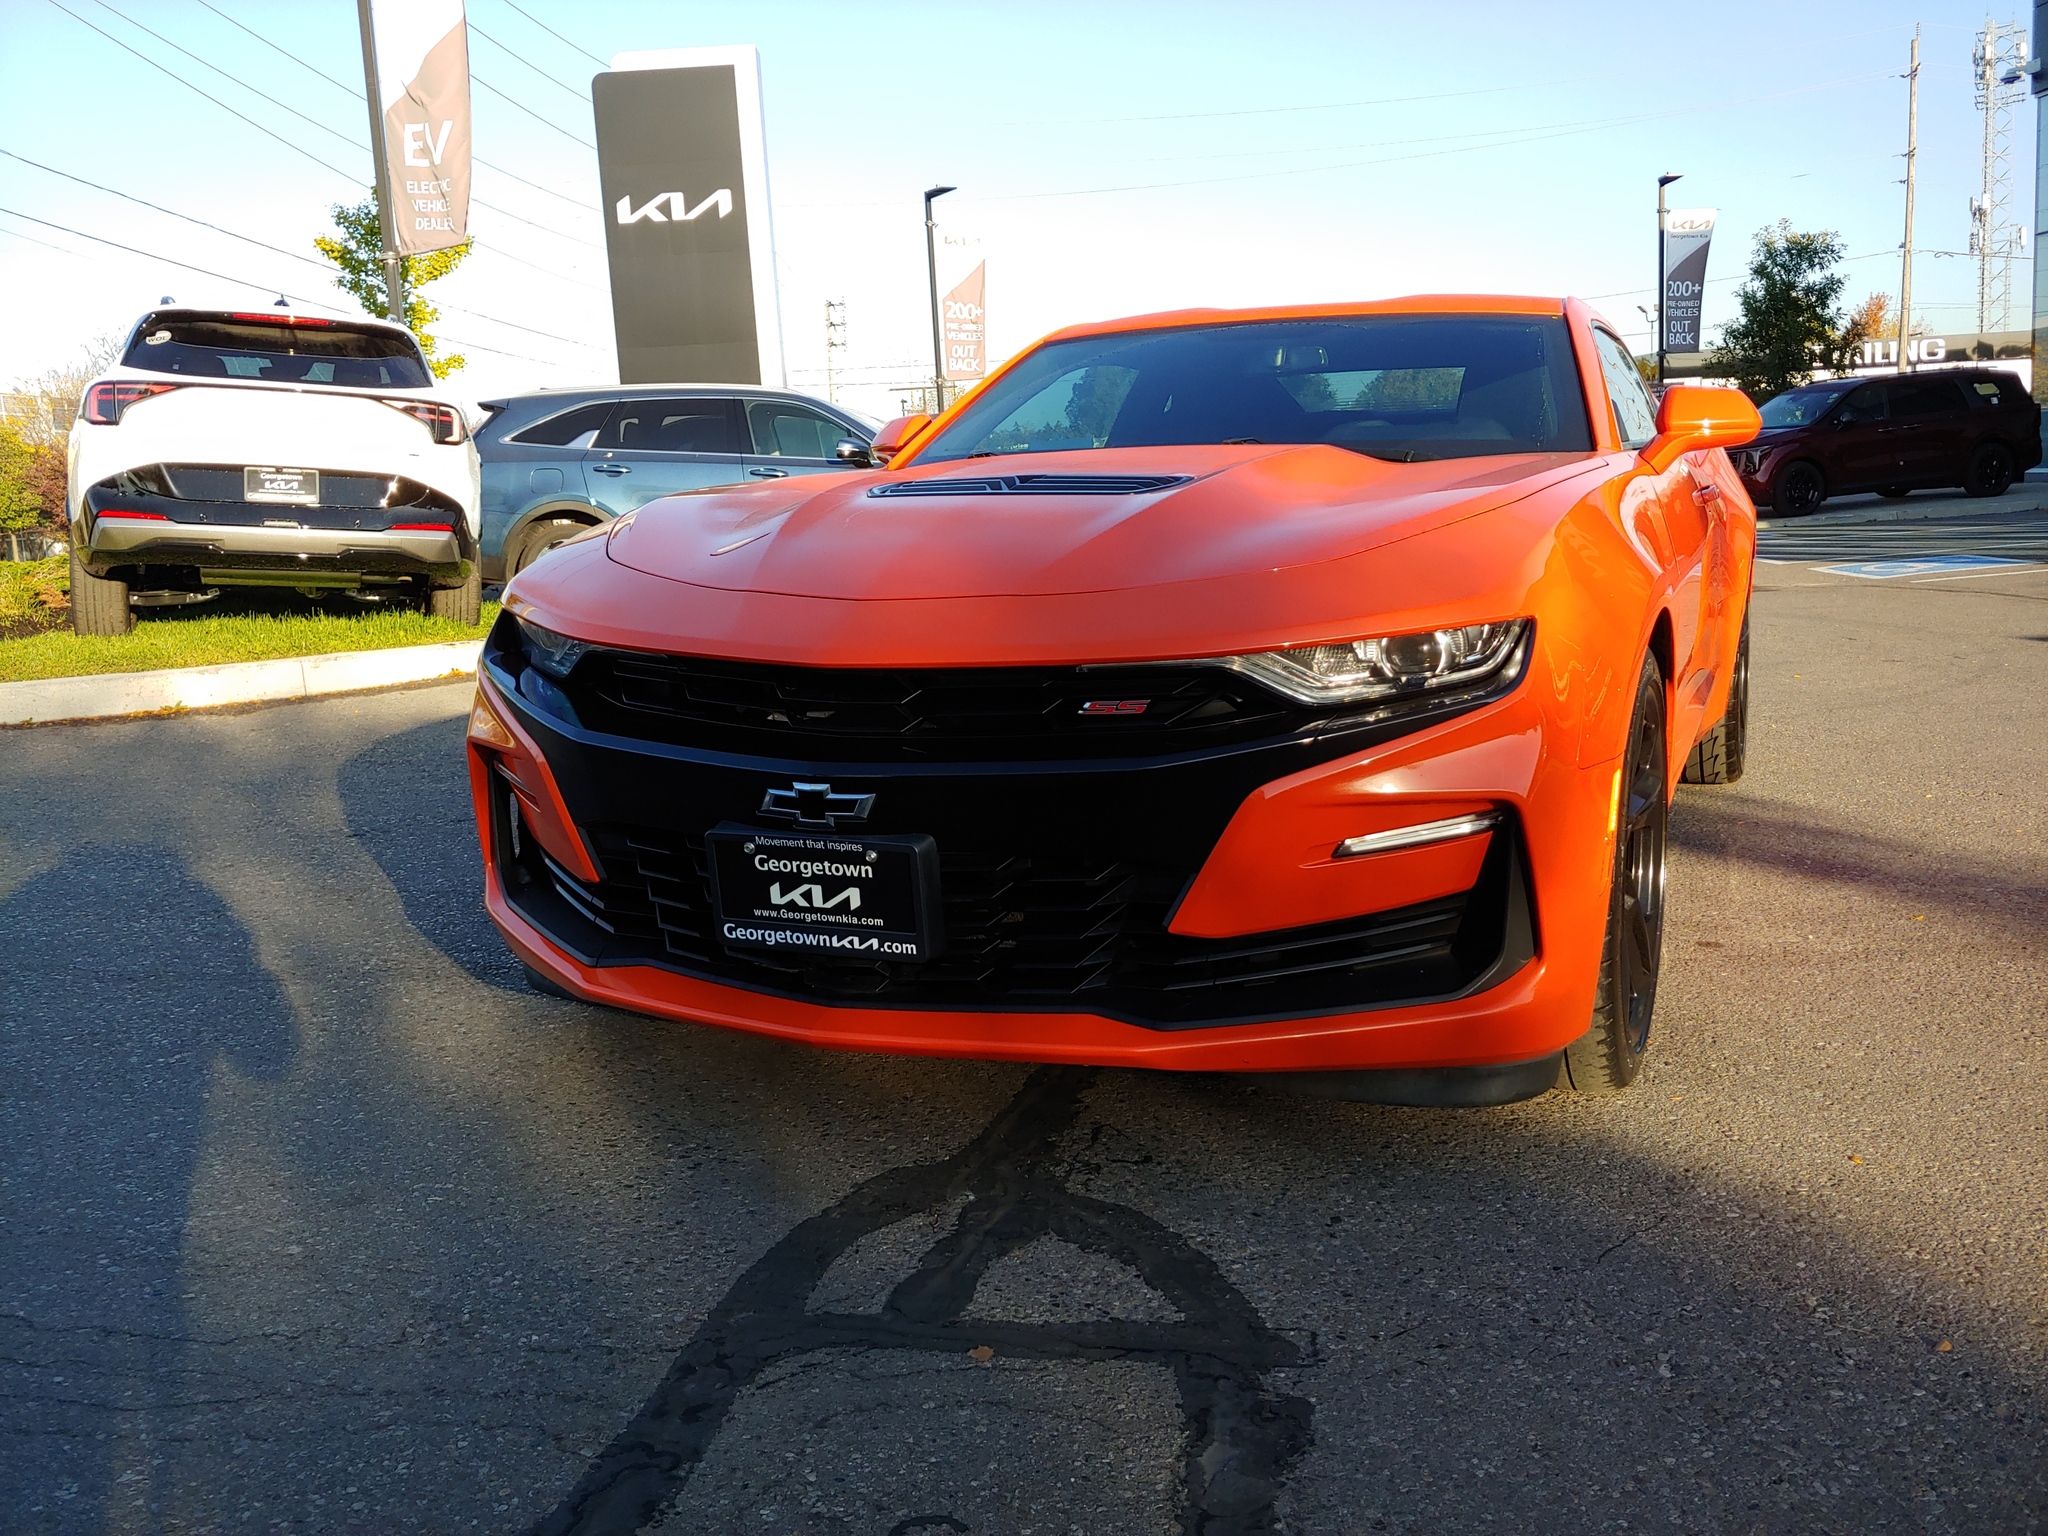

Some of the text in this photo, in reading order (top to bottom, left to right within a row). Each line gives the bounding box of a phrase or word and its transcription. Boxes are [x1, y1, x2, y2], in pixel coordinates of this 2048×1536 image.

[403, 119, 454, 168] EV
[616, 188, 733, 224] KIA
[1667, 280, 1702, 297] 200+
[945, 300, 984, 320] 200+
[1667, 300, 1700, 308] PRE-OWNED
[1667, 308, 1699, 317] VEHICLES
[1670, 320, 1692, 333] OUT
[1669, 332, 1695, 345] BACK
[951, 345, 977, 358] OUT
[949, 358, 982, 372] BACK
[1078, 699, 1151, 715] SS
[755, 836, 863, 853] Movement that inspires
[754, 854, 874, 879] Georgetown
[769, 881, 861, 911] KIA
[753, 908, 884, 927] www.Georgetownkia.com
